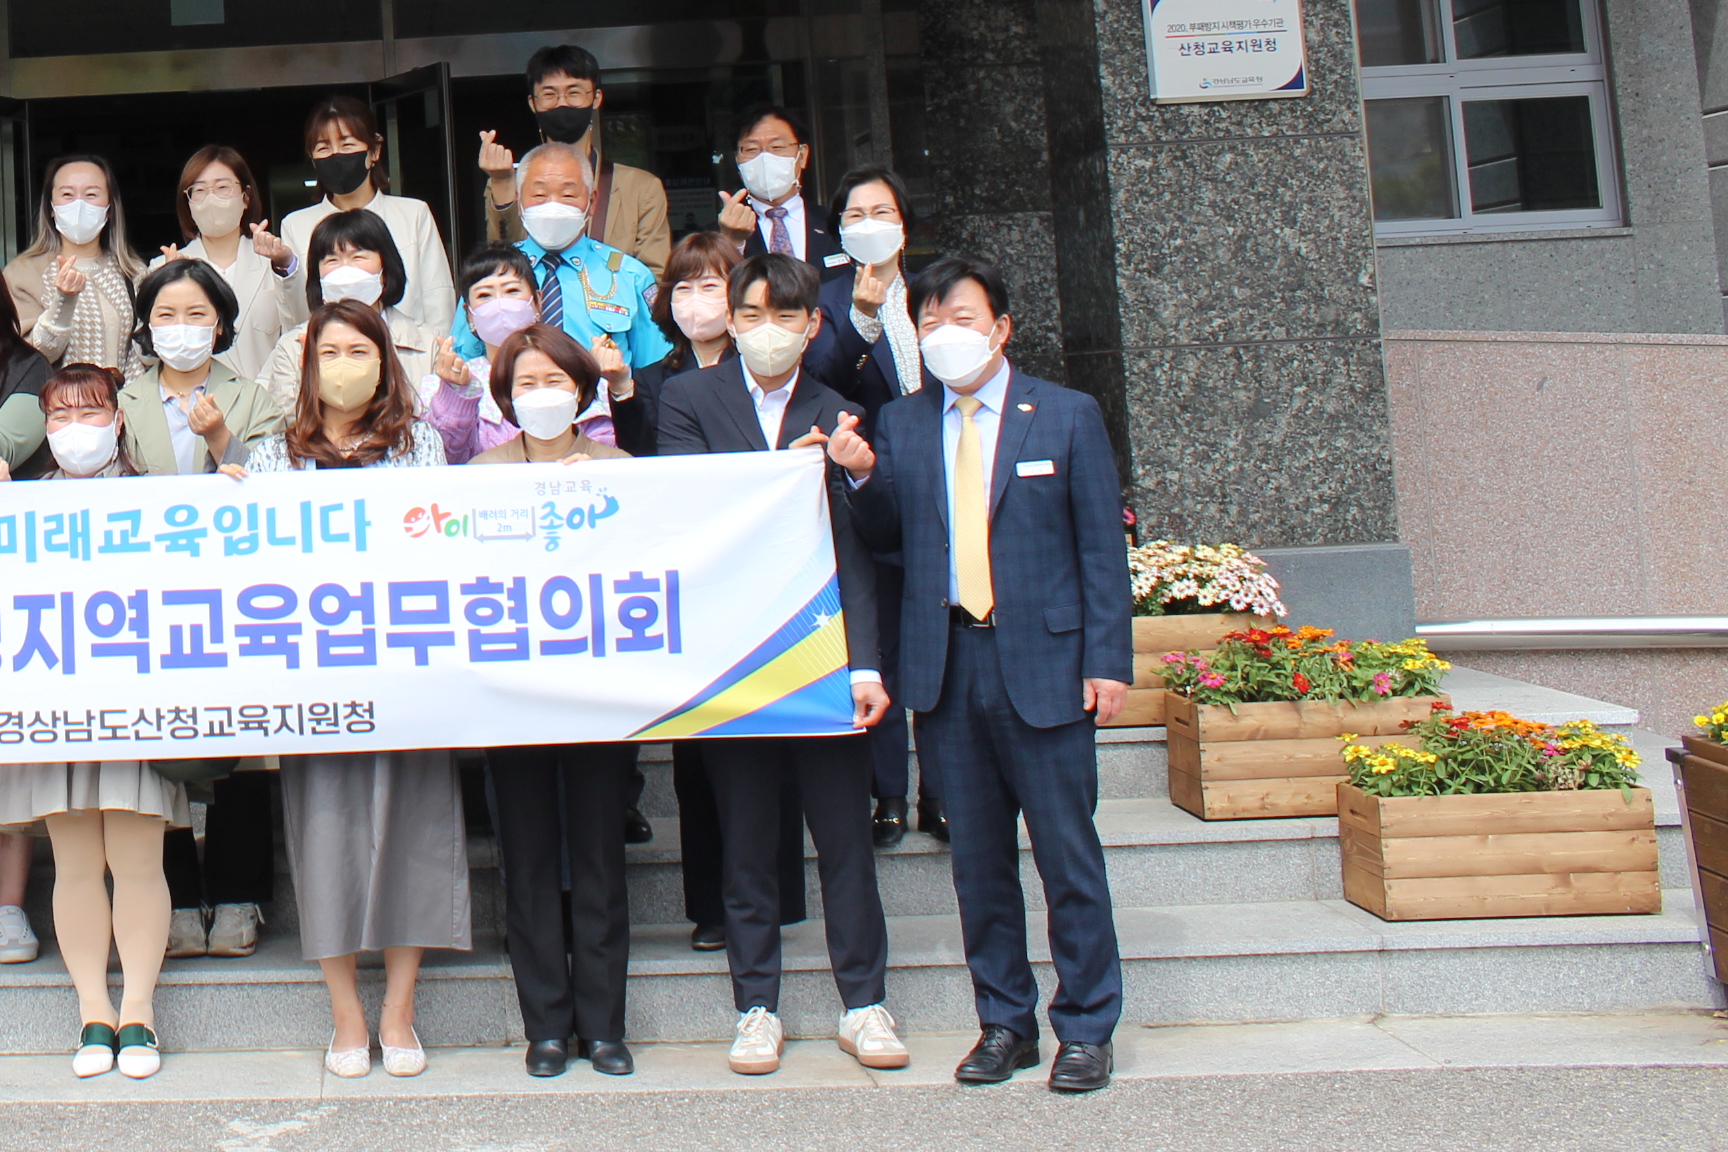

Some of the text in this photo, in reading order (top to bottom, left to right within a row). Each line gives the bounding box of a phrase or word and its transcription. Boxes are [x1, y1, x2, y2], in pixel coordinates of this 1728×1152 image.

[1167, 23, 1188, 33] 2020.
[1178, 38, 1277, 57] 산청교육지원청
[534, 479, 593, 496] 경남교육
[478, 507, 529, 520] 배려의 거리
[497, 523, 512, 532] 2m
